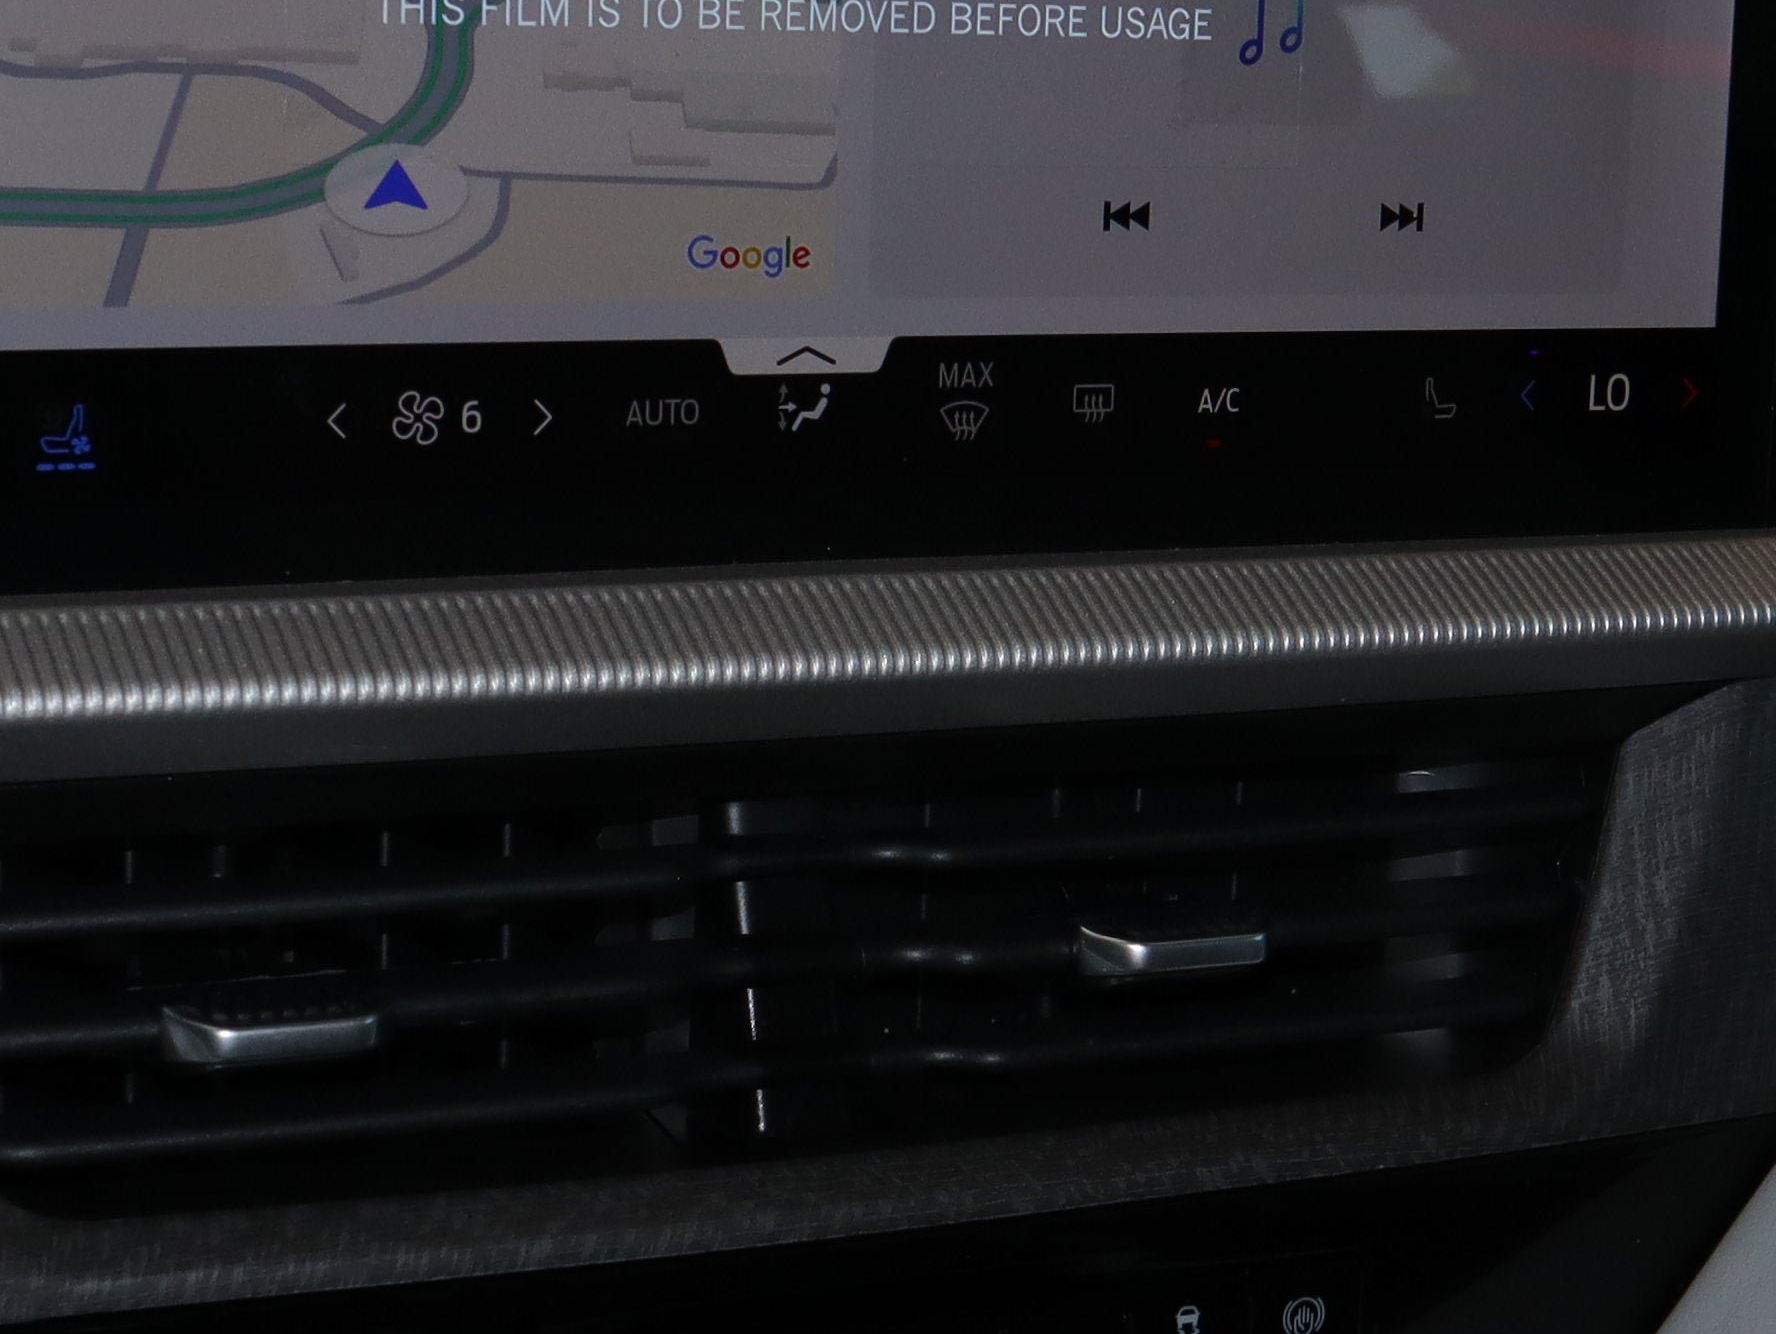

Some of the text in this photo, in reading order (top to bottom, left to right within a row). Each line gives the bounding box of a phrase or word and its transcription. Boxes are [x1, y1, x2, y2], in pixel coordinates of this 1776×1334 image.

[950, 1, 1088, 40] BEFORE
[1100, 5, 1214, 42] USAGE
[686, 235, 812, 278] Google
[937, 361, 995, 389] MAX
[1587, 371, 1633, 413] LO
[460, 399, 483, 435] 6
[624, 397, 701, 429] AUTO
[1197, 386, 1241, 415] A/C
